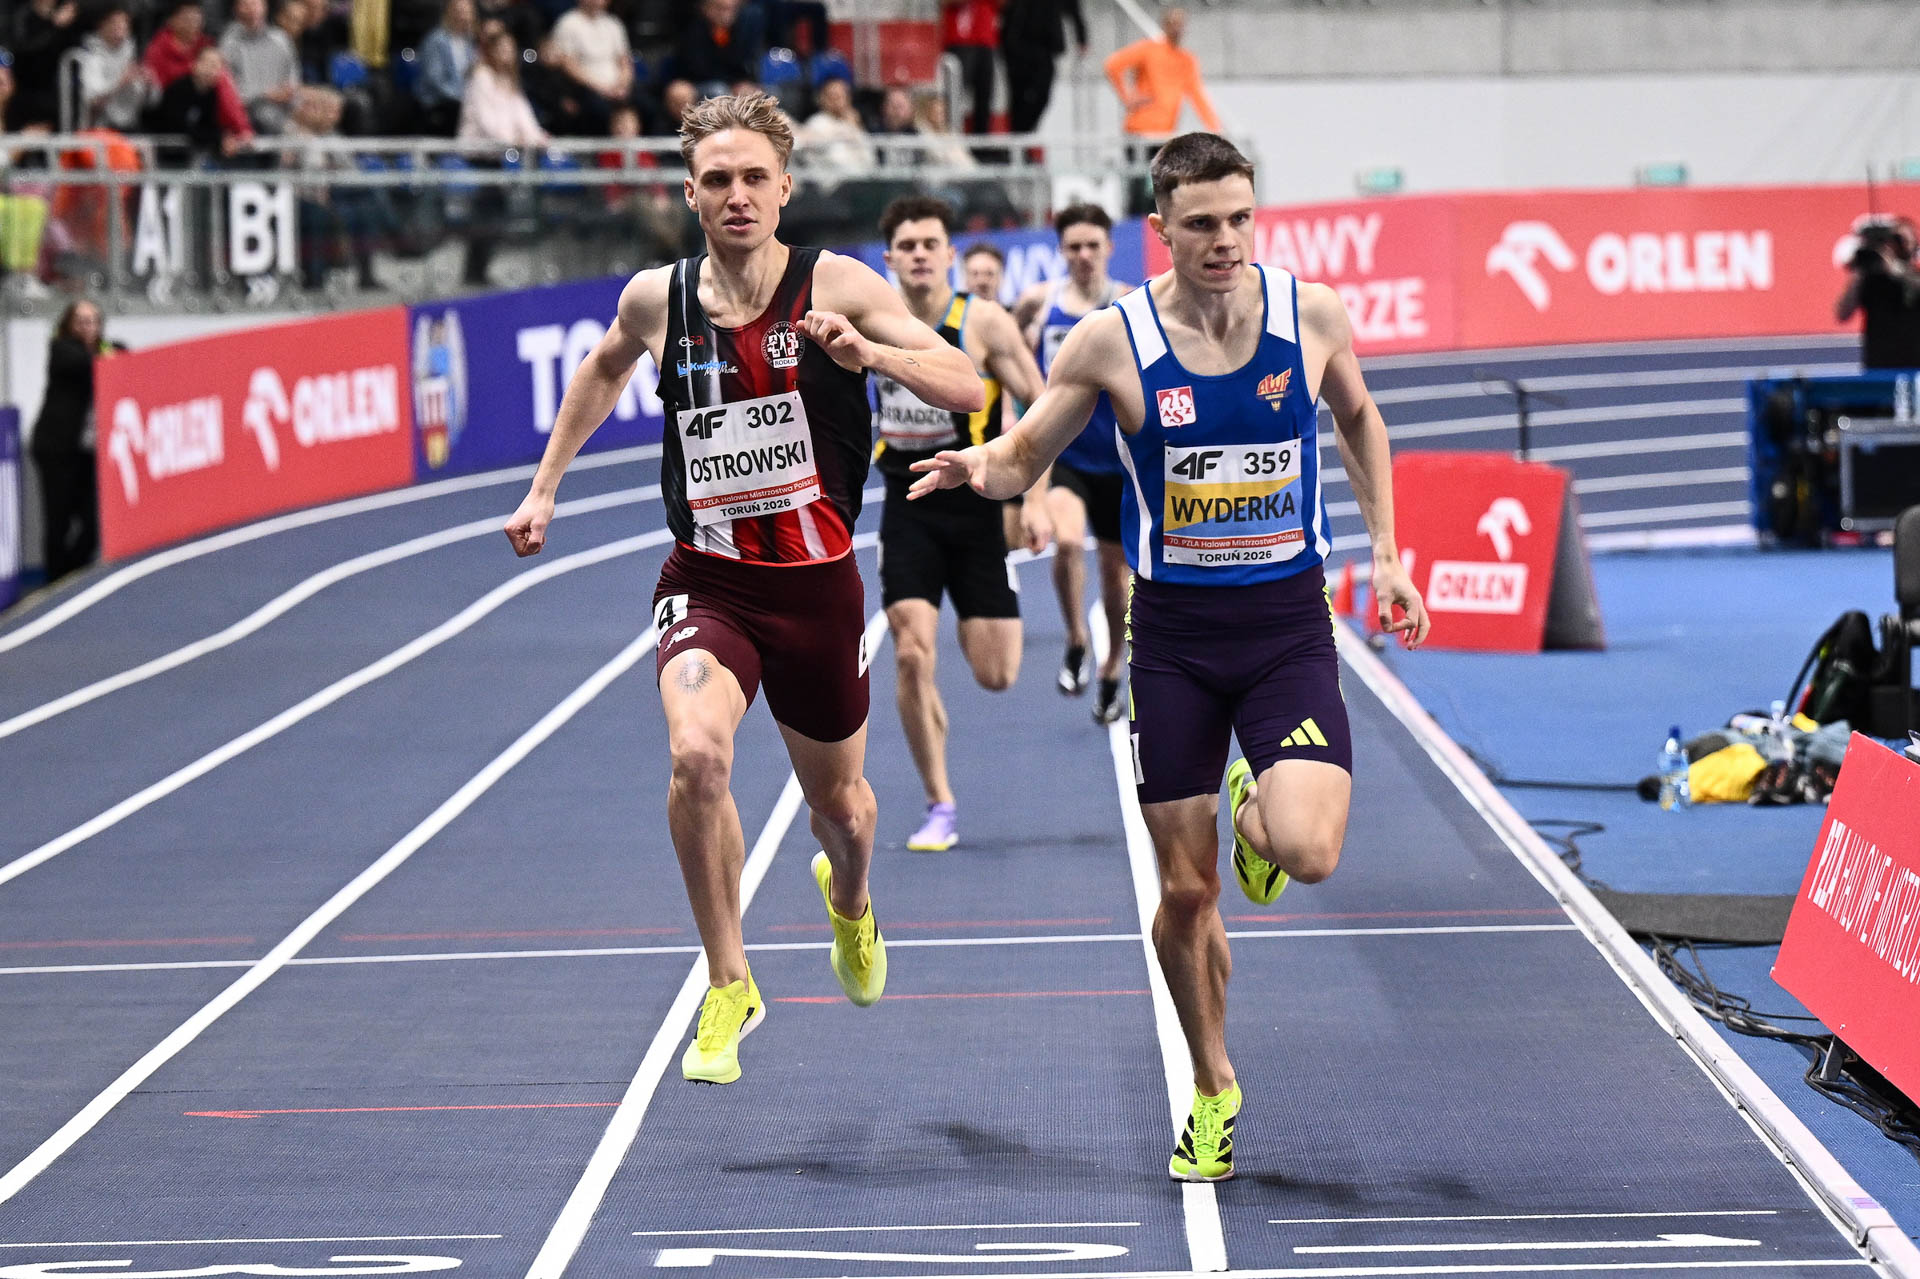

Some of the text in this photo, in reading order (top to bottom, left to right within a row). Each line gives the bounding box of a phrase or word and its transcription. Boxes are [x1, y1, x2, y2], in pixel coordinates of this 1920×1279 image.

[229, 182, 295, 275] B1
[1586, 229, 1774, 294] ORLEN
[1257, 368, 1292, 395] AWF
[292, 363, 399, 447] ORLEN
[686, 402, 794, 440] 4F 302
[690, 440, 807, 484] OSTROWSKI
[1172, 450, 1291, 480] 4F 359
[703, 498, 721, 507] PZLA
[721, 493, 749, 503] Halowe
[749, 485, 793, 499] Mistrzostwa
[793, 479, 814, 490] Polski
[720, 499, 791, 517] TORUŃ 2026
[1171, 491, 1295, 523] WYDERKA
[1182, 539, 1200, 548] PZLA
[1201, 540, 1231, 548] Halowe
[1232, 537, 1277, 547] Mistrzostwa
[1277, 533, 1299, 542] Polski
[1197, 550, 1272, 562] TORUŃ 2026
[1436, 573, 1515, 599] ORLEN
[658, 598, 677, 630] 4
[1806, 817, 1853, 914] PZLA
[1829, 832, 1892, 946] HALOWE
